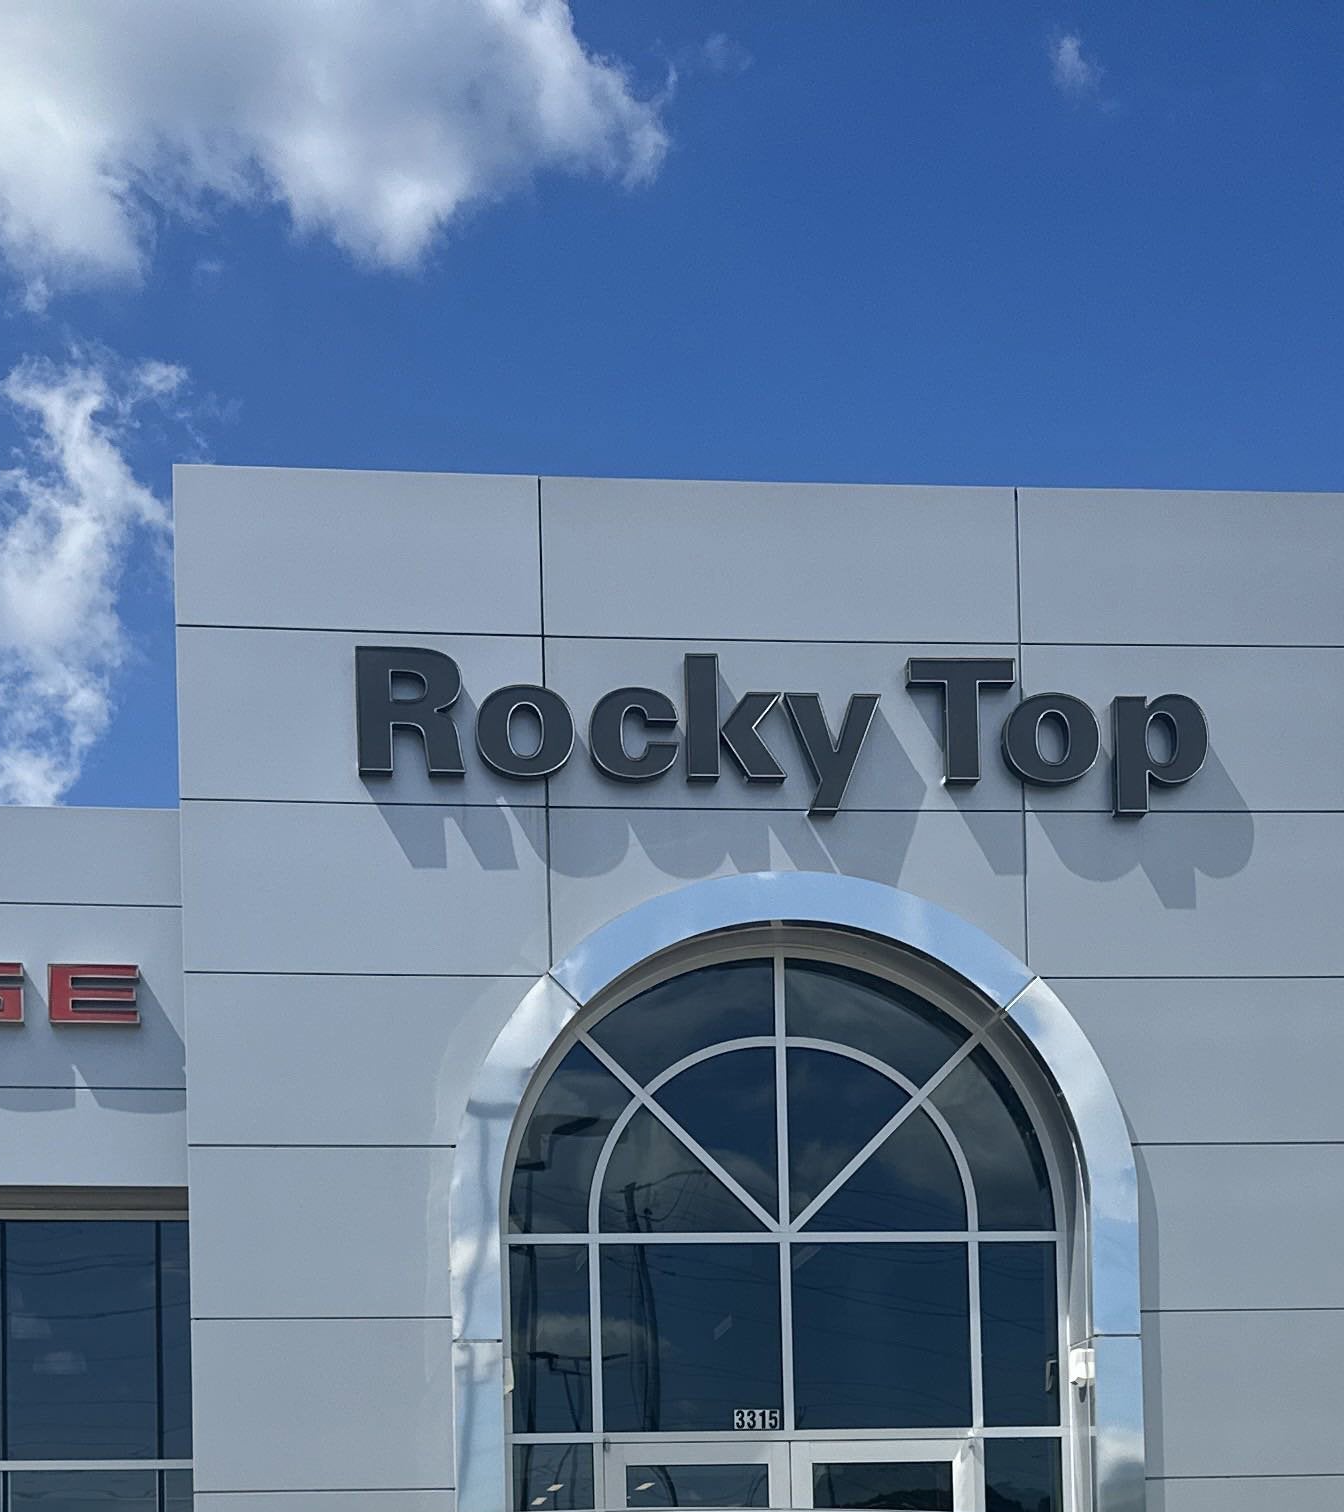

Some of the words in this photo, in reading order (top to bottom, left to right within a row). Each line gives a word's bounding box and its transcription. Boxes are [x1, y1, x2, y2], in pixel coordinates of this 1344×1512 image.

[354, 645, 880, 816] Rocky
[905, 657, 1210, 818] Top
[735, 1410, 778, 1429] 3315
